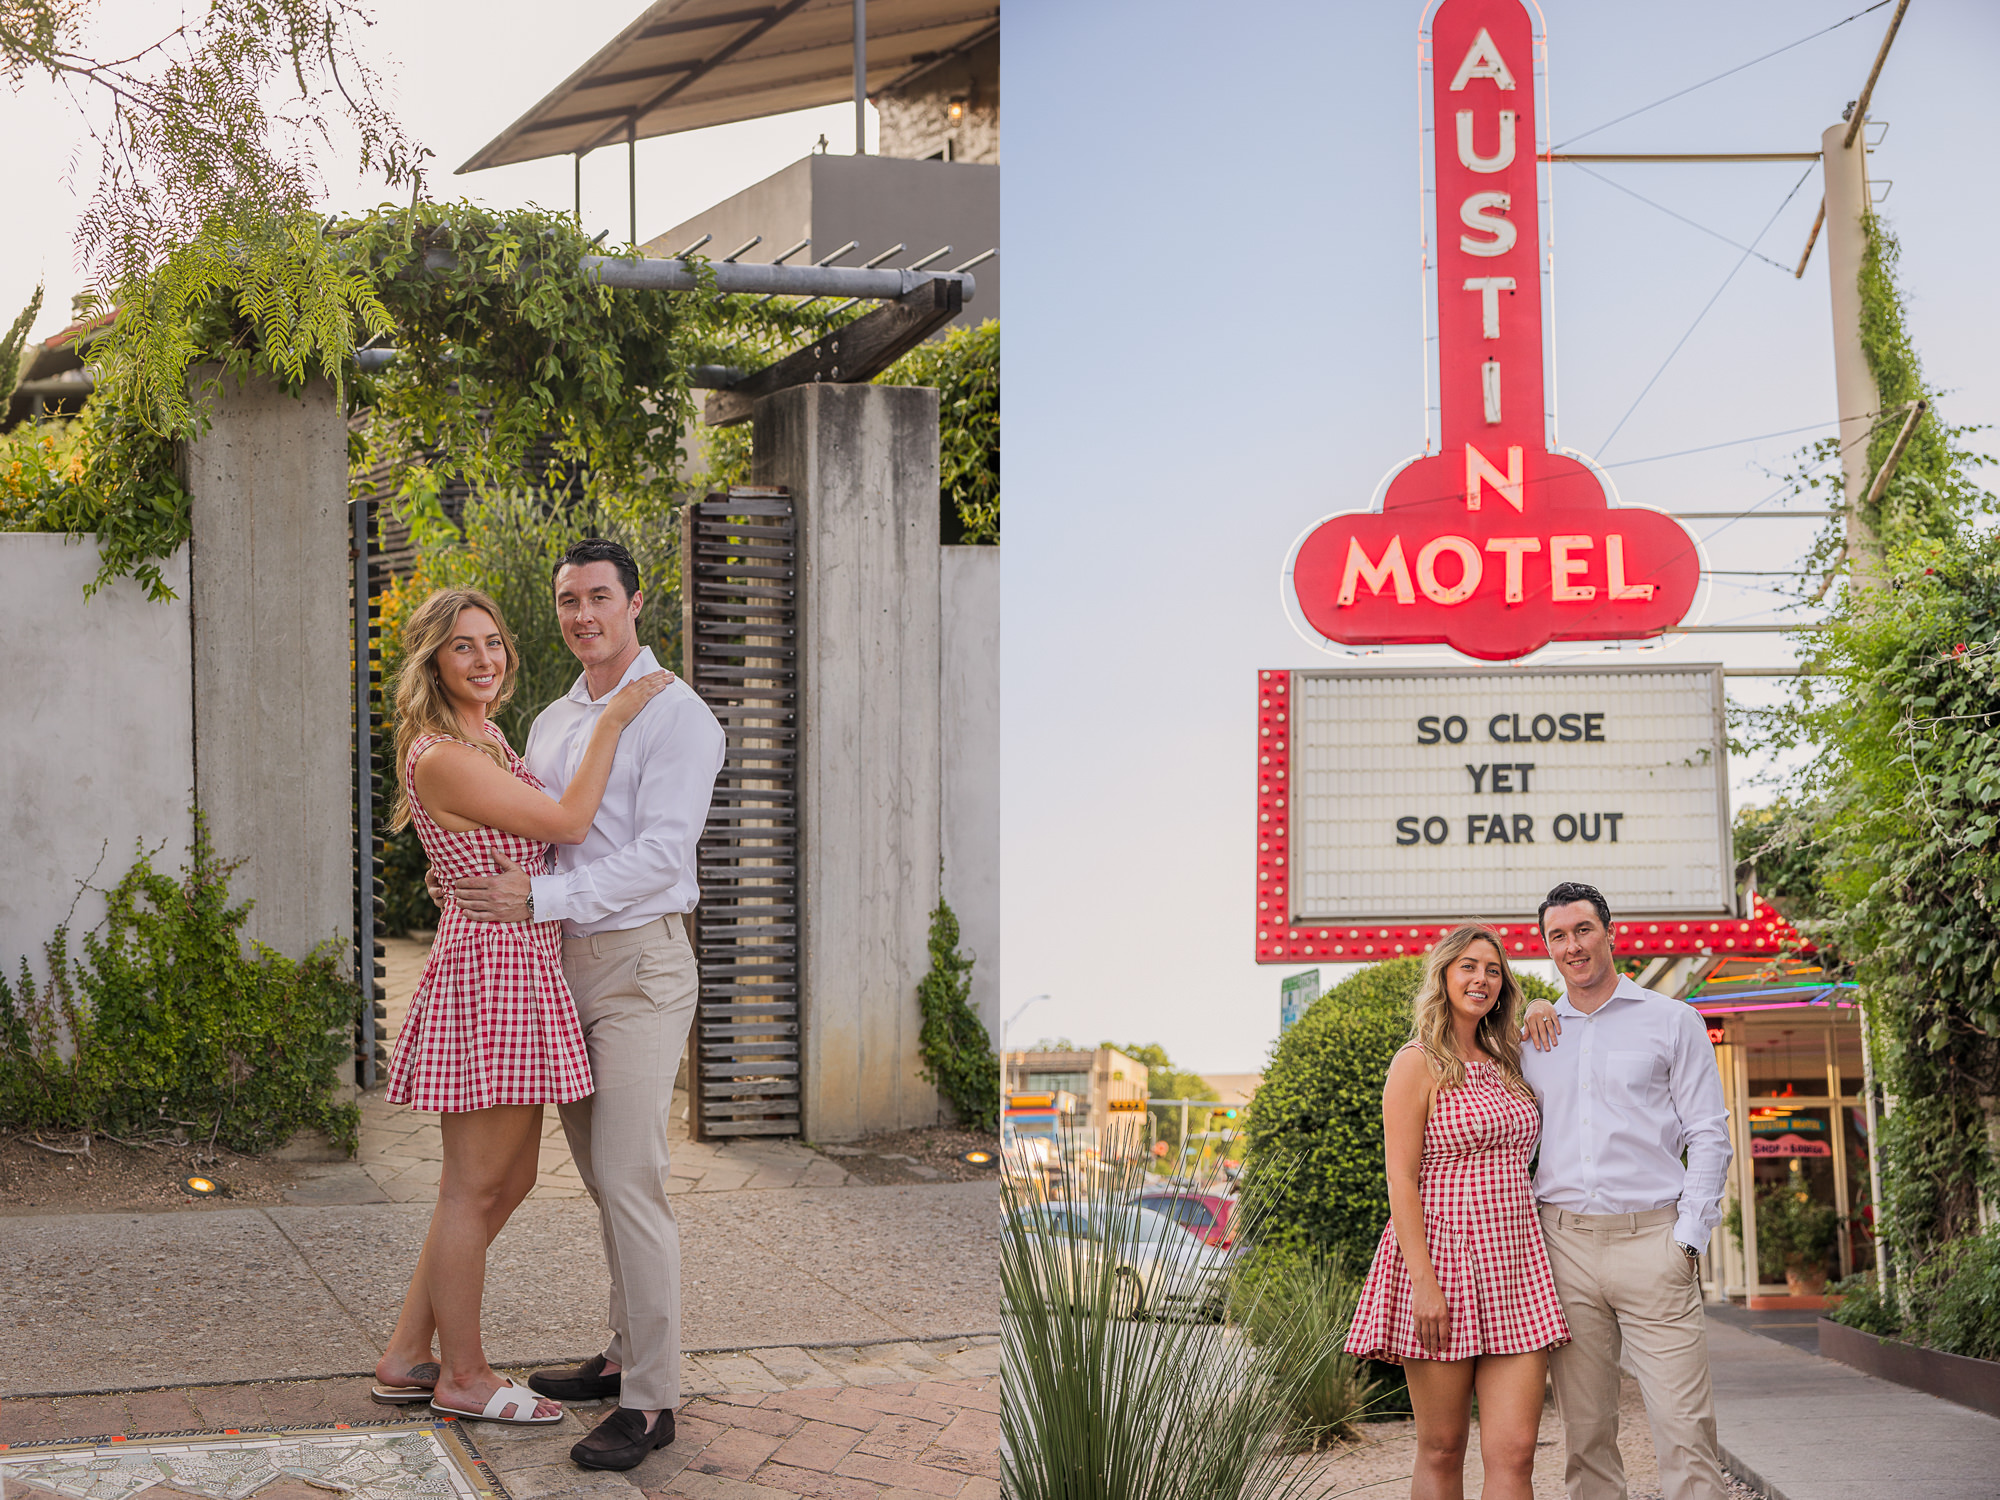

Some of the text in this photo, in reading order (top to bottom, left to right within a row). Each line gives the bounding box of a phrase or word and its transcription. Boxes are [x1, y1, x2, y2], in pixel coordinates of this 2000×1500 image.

[1449, 26, 1525, 512] AUSTIN
[1336, 534, 1655, 606] MOTEL
[1417, 712, 1605, 745] SO CLOSE
[1465, 763, 1535, 793] YET
[1396, 812, 1624, 846] SO FAR OUT
